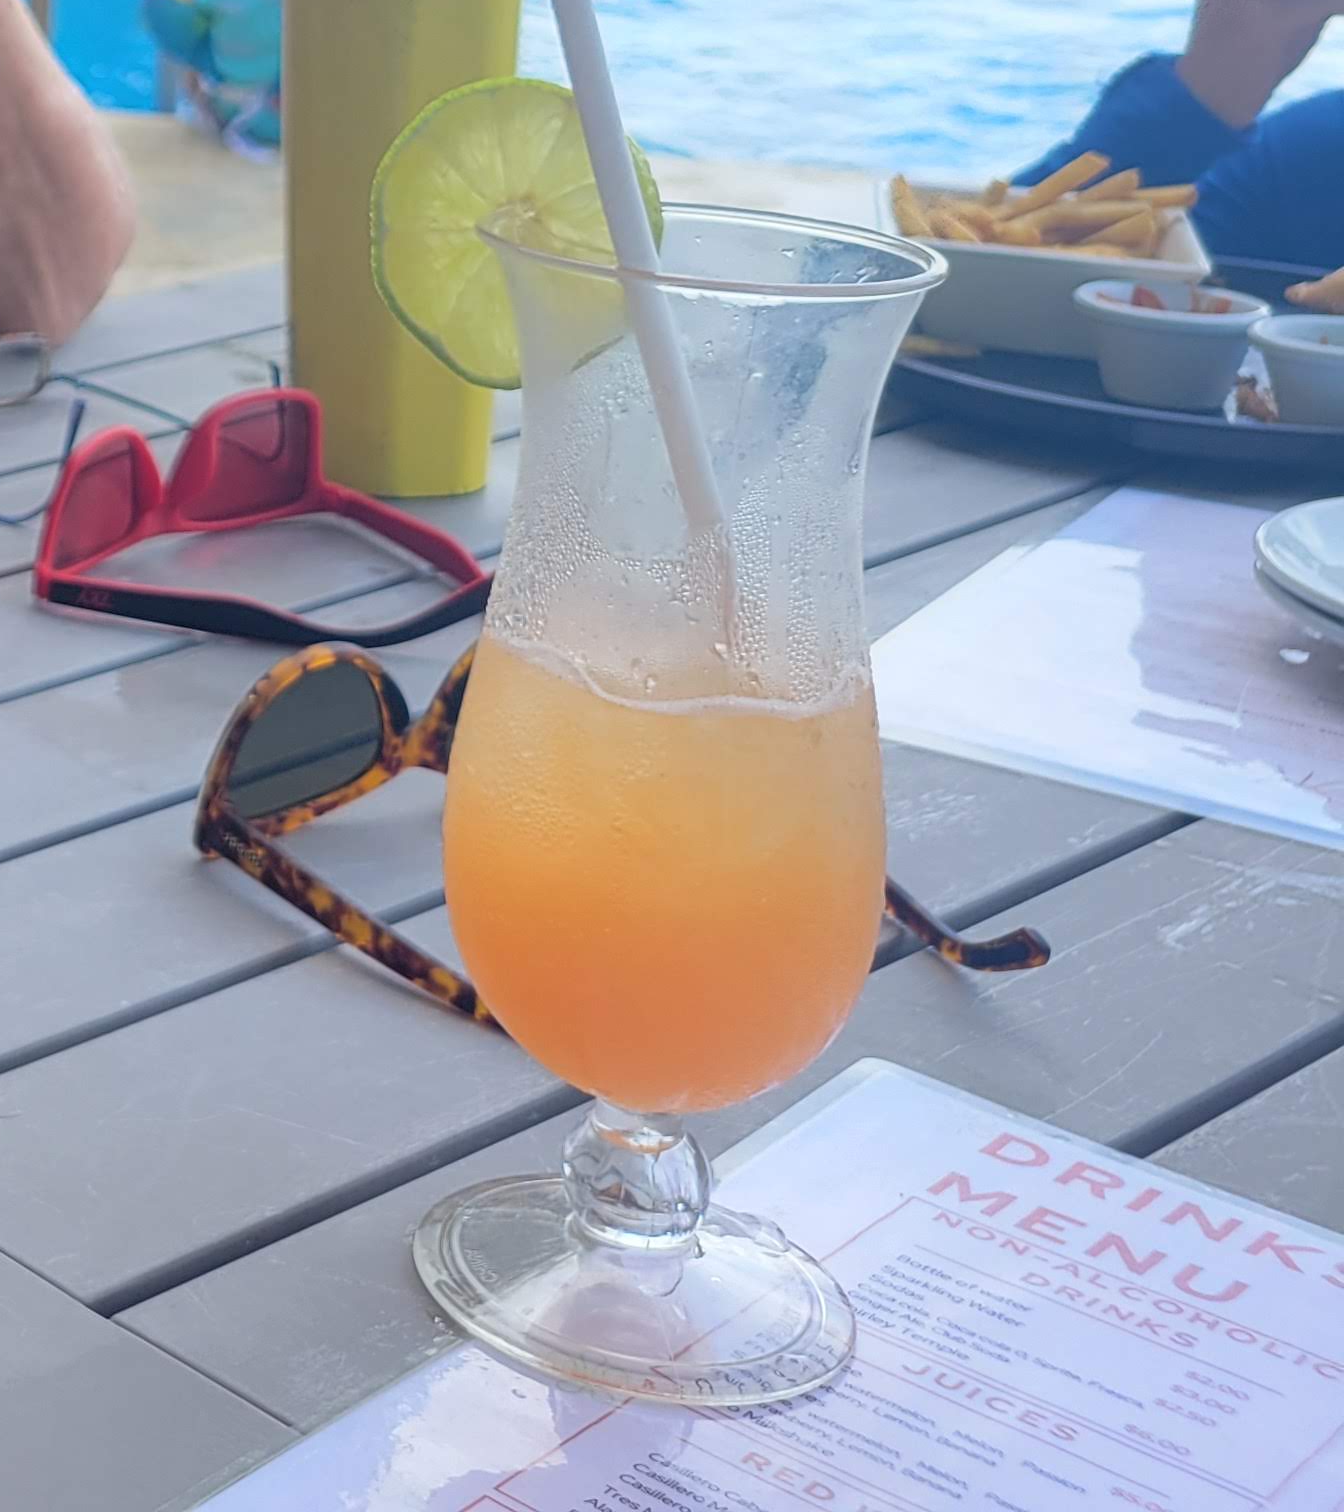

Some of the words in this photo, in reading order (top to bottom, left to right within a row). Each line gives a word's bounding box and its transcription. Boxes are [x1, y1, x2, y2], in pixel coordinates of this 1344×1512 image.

[926, 1170, 1251, 1303] MENU
[857, 1282, 897, 1303] Coca
[936, 1316, 978, 1338] Coca
[868, 1273, 926, 1302] Sodas
[880, 1264, 966, 1305] Sparkling
[968, 1298, 1027, 1328] Water
[896, 1254, 953, 1281] Bottle
[955, 1279, 979, 1291] of
[979, 1289, 1033, 1312] water
[931, 1210, 1344, 1381] NON-ALCOHOLIC
[1019, 1270, 1201, 1349] DRINKS
[847, 1289, 899, 1316] Ginger
[931, 1325, 968, 1345] Club
[968, 1340, 1011, 1364] Soda
[852, 1305, 897, 1329] irley
[901, 1327, 971, 1361] Temple
[900, 1363, 1081, 1442] JUICES
[742, 1409, 835, 1457] Milkshake
[603, 1483, 642, 1511] Tres
[632, 1462, 706, 1505] Casillero
[647, 1452, 721, 1492] Casillero
[741, 1450, 836, 1501] RED
